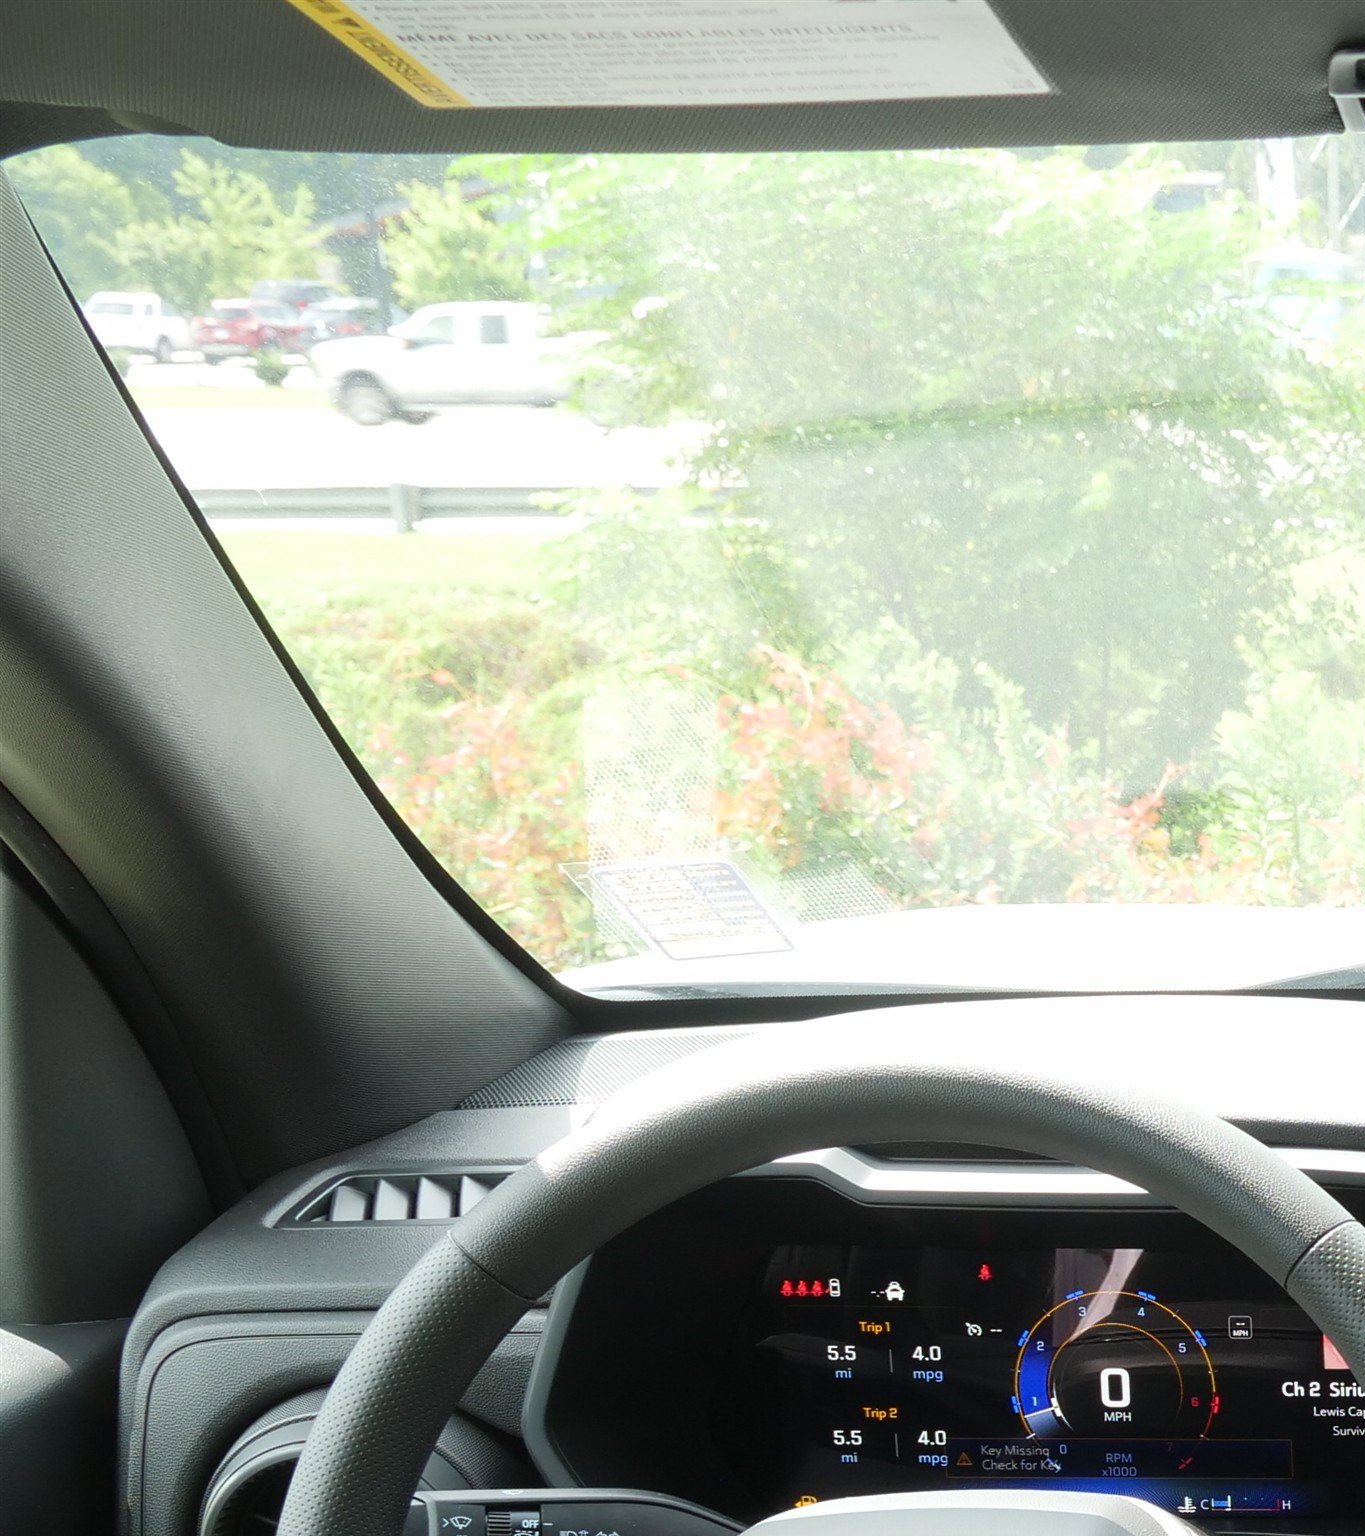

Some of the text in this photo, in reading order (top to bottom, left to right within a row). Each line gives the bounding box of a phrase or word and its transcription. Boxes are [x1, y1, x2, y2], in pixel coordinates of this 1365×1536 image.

[1079, 1306, 1087, 1318] 3
[1137, 1306, 1145, 1318] 4
[858, 1322, 891, 1334] Trip 1
[1037, 1341, 1045, 1352] 2
[1178, 1342, 1187, 1355] 5
[827, 1346, 857, 1361] 5.5
[912, 1346, 942, 1361] 4.0
[835, 1368, 852, 1379] mi
[913, 1369, 944, 1383] mpg
[1100, 1367, 1131, 1408] 0
[1281, 1381, 1305, 1397] Ch
[1309, 1381, 1321, 1397] 2
[863, 1408, 898, 1421] Trip 2
[1104, 1411, 1132, 1423] MPH
[1313, 1406, 1345, 1417] Lewis
[833, 1431, 863, 1446] 5.5
[917, 1431, 947, 1446] 4.0
[980, 1444, 1050, 1459] Key Missing
[841, 1452, 859, 1464] mi
[918, 1453, 949, 1467] mpg
[1105, 1453, 1134, 1465] RPM
[982, 1459, 1063, 1473] Check for Key
[1101, 1466, 1138, 1478] x1000
[1200, 1499, 1210, 1510] C
[1282, 1499, 1292, 1510] H
[522, 1520, 539, 1529] OFF
